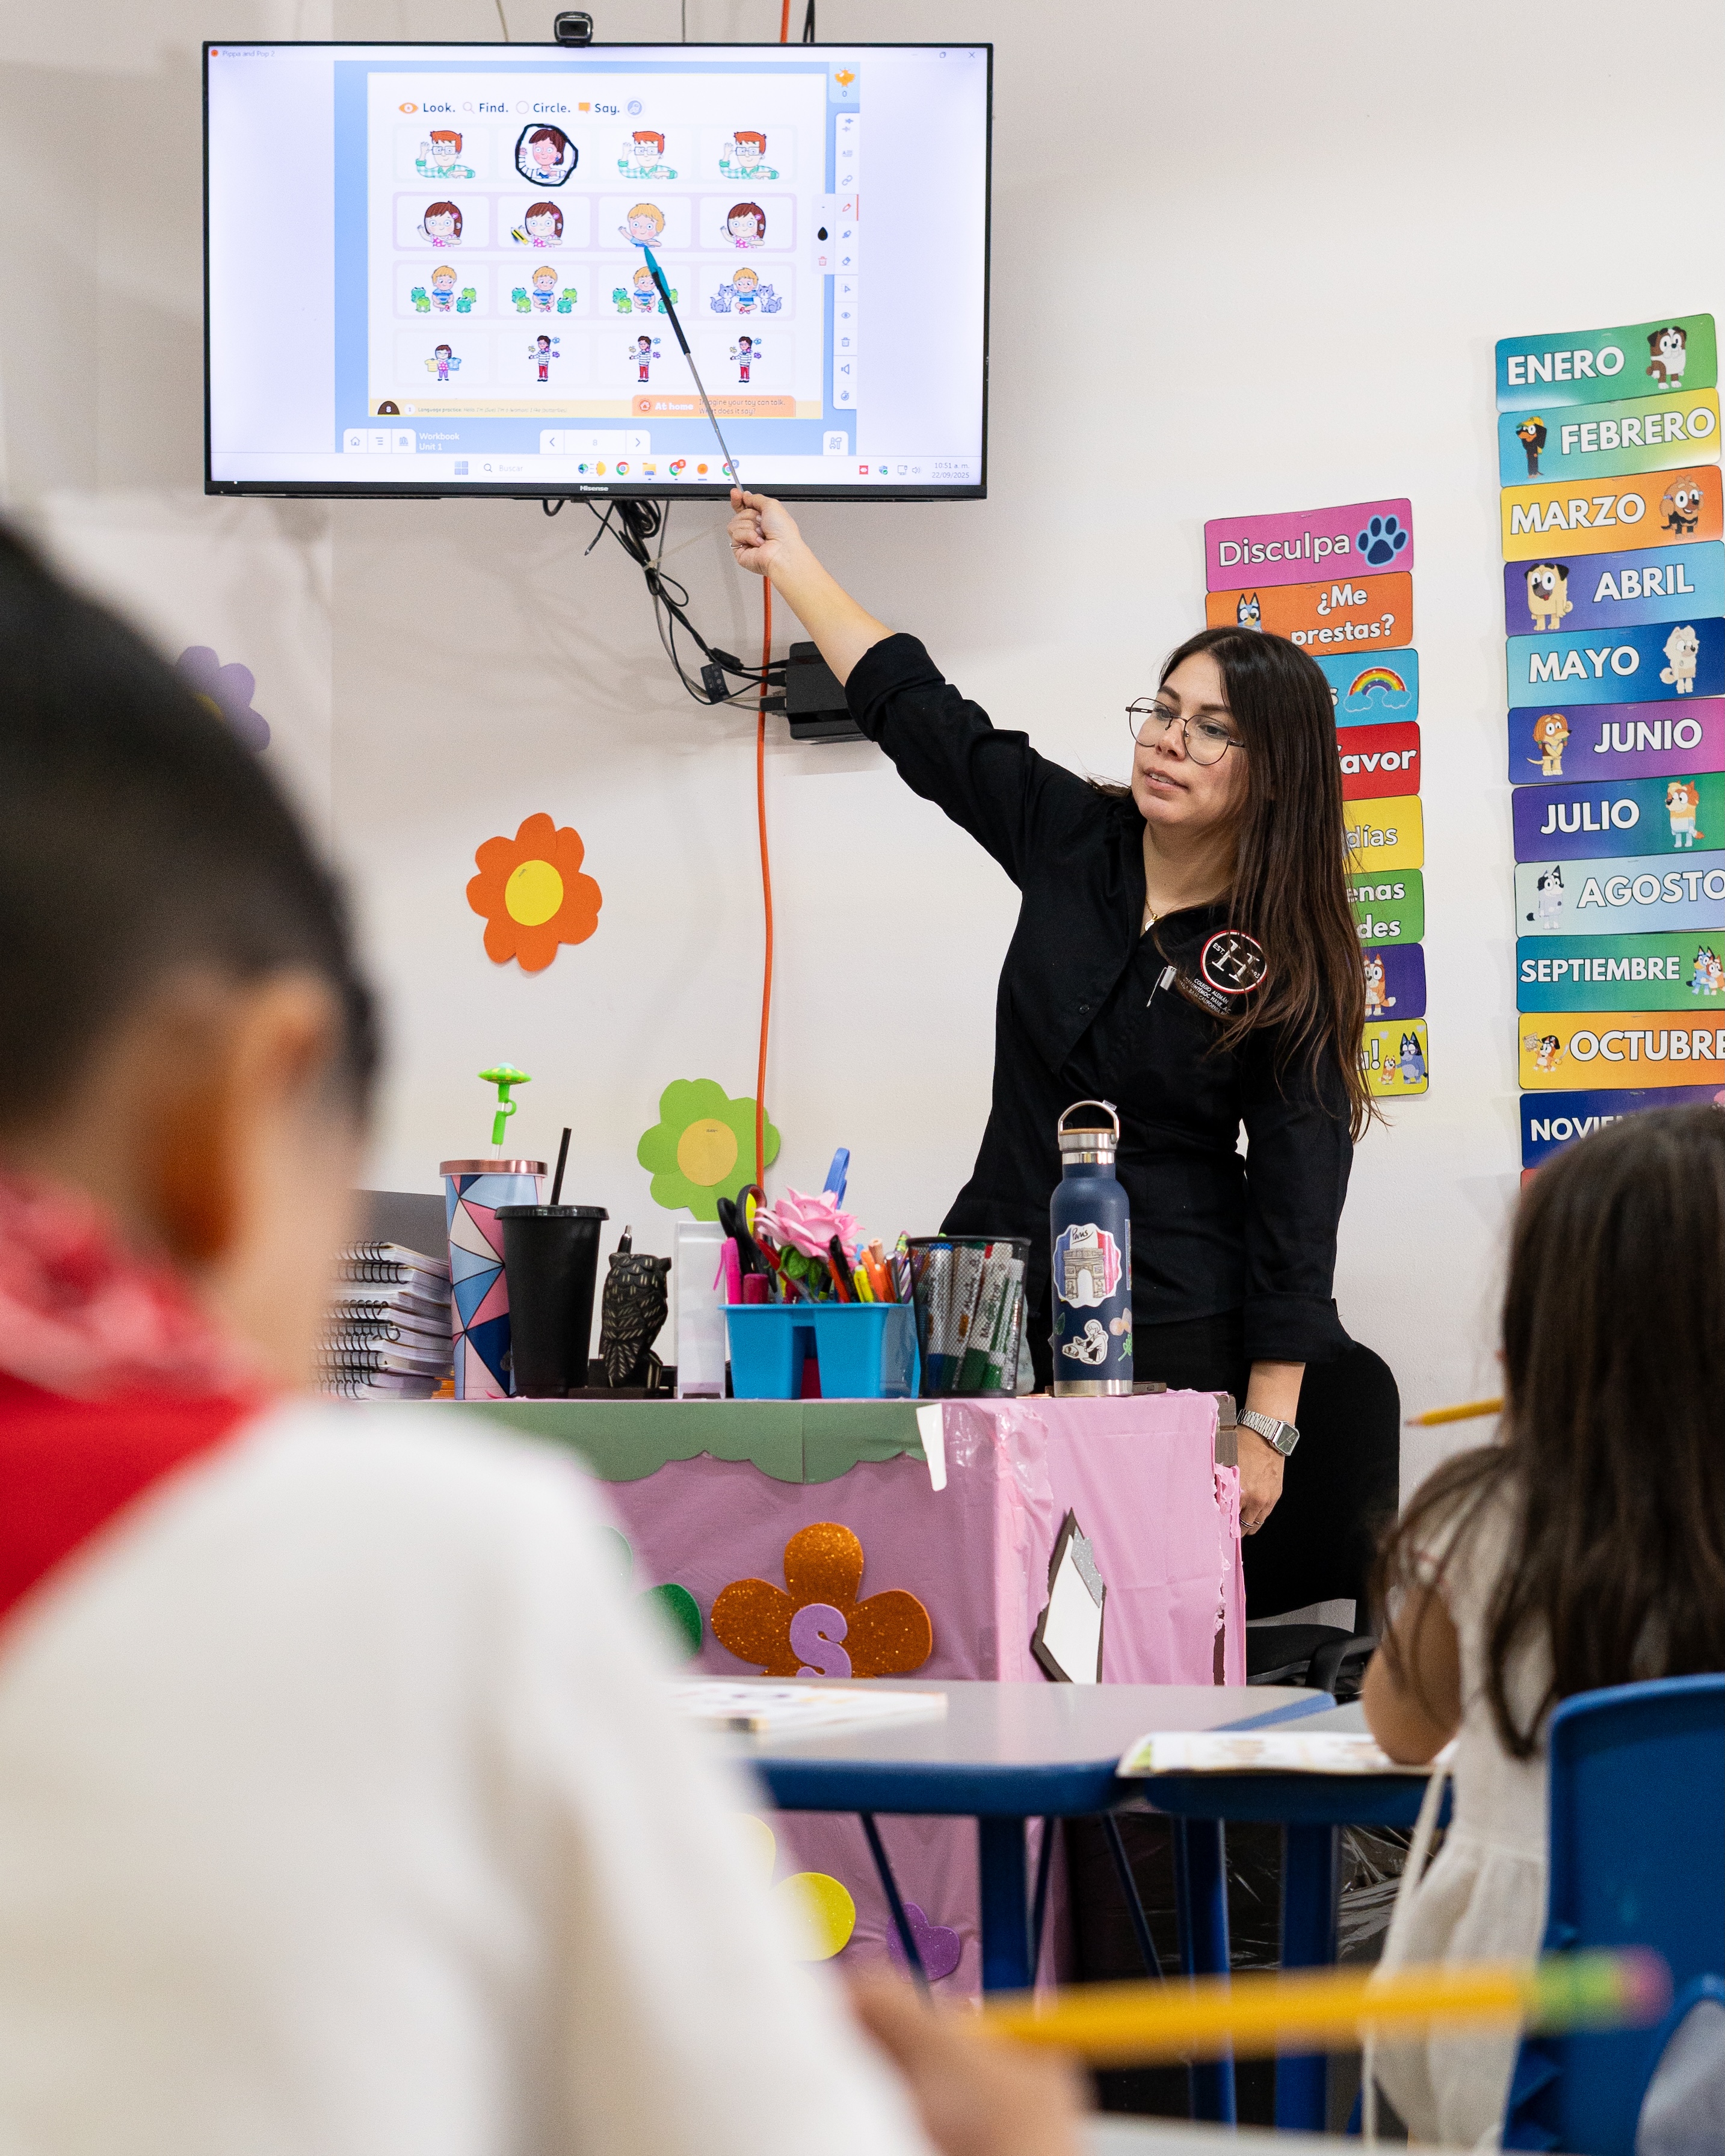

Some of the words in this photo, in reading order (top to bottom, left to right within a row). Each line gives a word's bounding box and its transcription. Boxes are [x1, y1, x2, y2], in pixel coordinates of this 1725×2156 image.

[423, 103, 455, 112] Look.
[479, 102, 508, 112] Find.
[533, 102, 571, 113] Circle.
[594, 103, 620, 115] Say.
[1507, 346, 1625, 386] ENERO
[668, 402, 694, 410] home
[699, 398, 727, 407] Iagine
[1561, 407, 1716, 455] FEBRERO
[1511, 492, 1646, 535] MARZO
[1218, 532, 1350, 567] Disculpa
[1316, 583, 1368, 616] ¿Me
[1592, 564, 1695, 603] ABRIL
[1291, 612, 1395, 646] prestas?
[1529, 645, 1640, 683] MAYO
[1593, 718, 1703, 754] JUNIO
[1337, 745, 1418, 775] avor
[1540, 798, 1640, 834] JULIO
[1346, 824, 1398, 849] días
[1576, 868, 1725, 909] AGOSTO
[1212, 942, 1225, 955] EST.
[1520, 956, 1680, 984] SEPTIEMBRE
[1194, 978, 1212, 992] COLEGIO
[1211, 990, 1229, 1004] ALEMÁN
[1569, 1029, 1725, 1062] OCTUBRE
[1072, 1228, 1089, 1241] Paris
[789, 1603, 852, 1678] S
